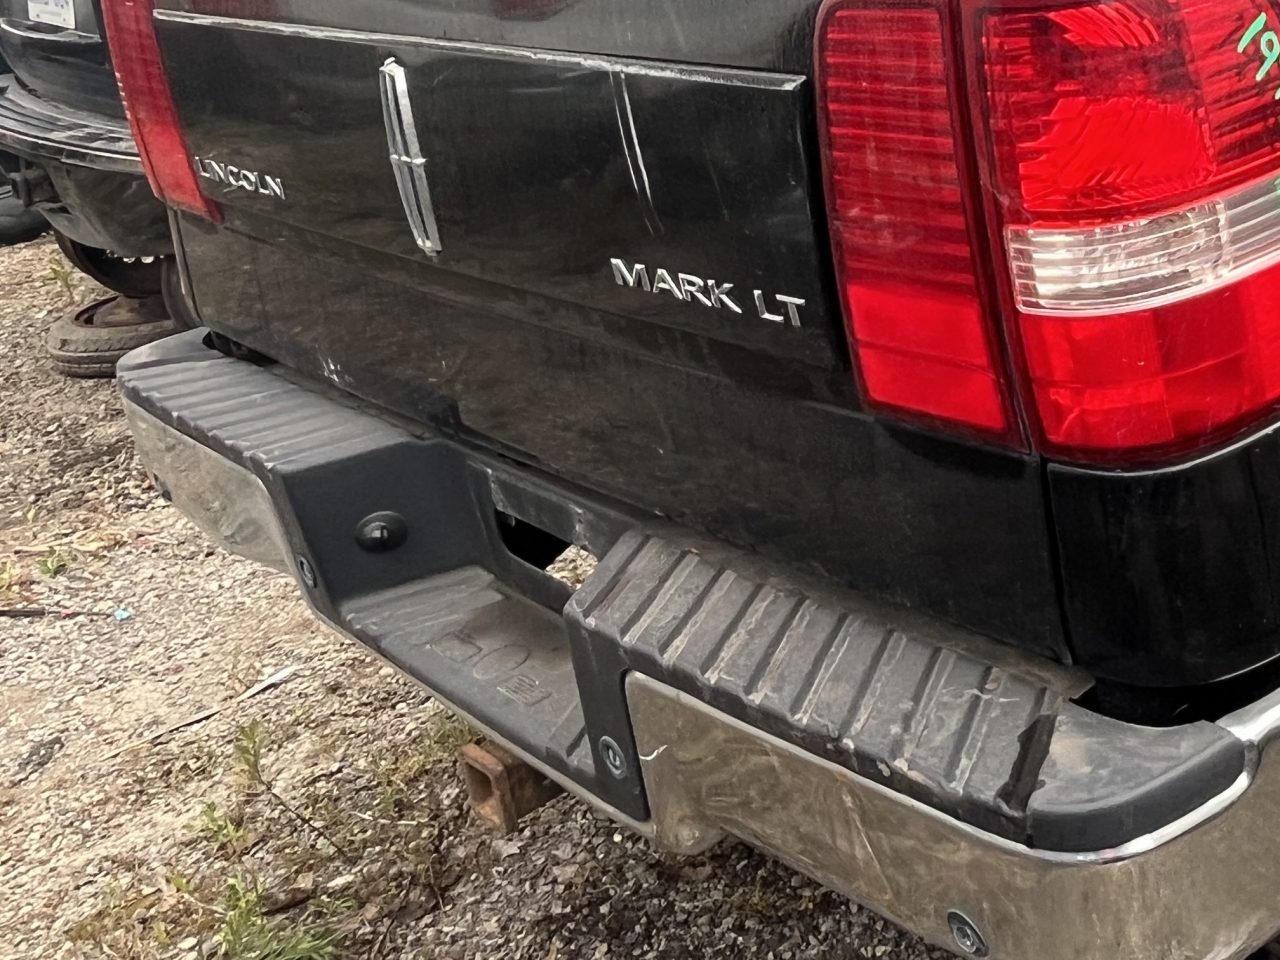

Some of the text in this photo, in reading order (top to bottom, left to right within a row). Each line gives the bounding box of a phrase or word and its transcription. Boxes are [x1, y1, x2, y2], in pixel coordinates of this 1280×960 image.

[193, 155, 286, 201] LINCOLN
[610, 257, 806, 328] MARK LT
